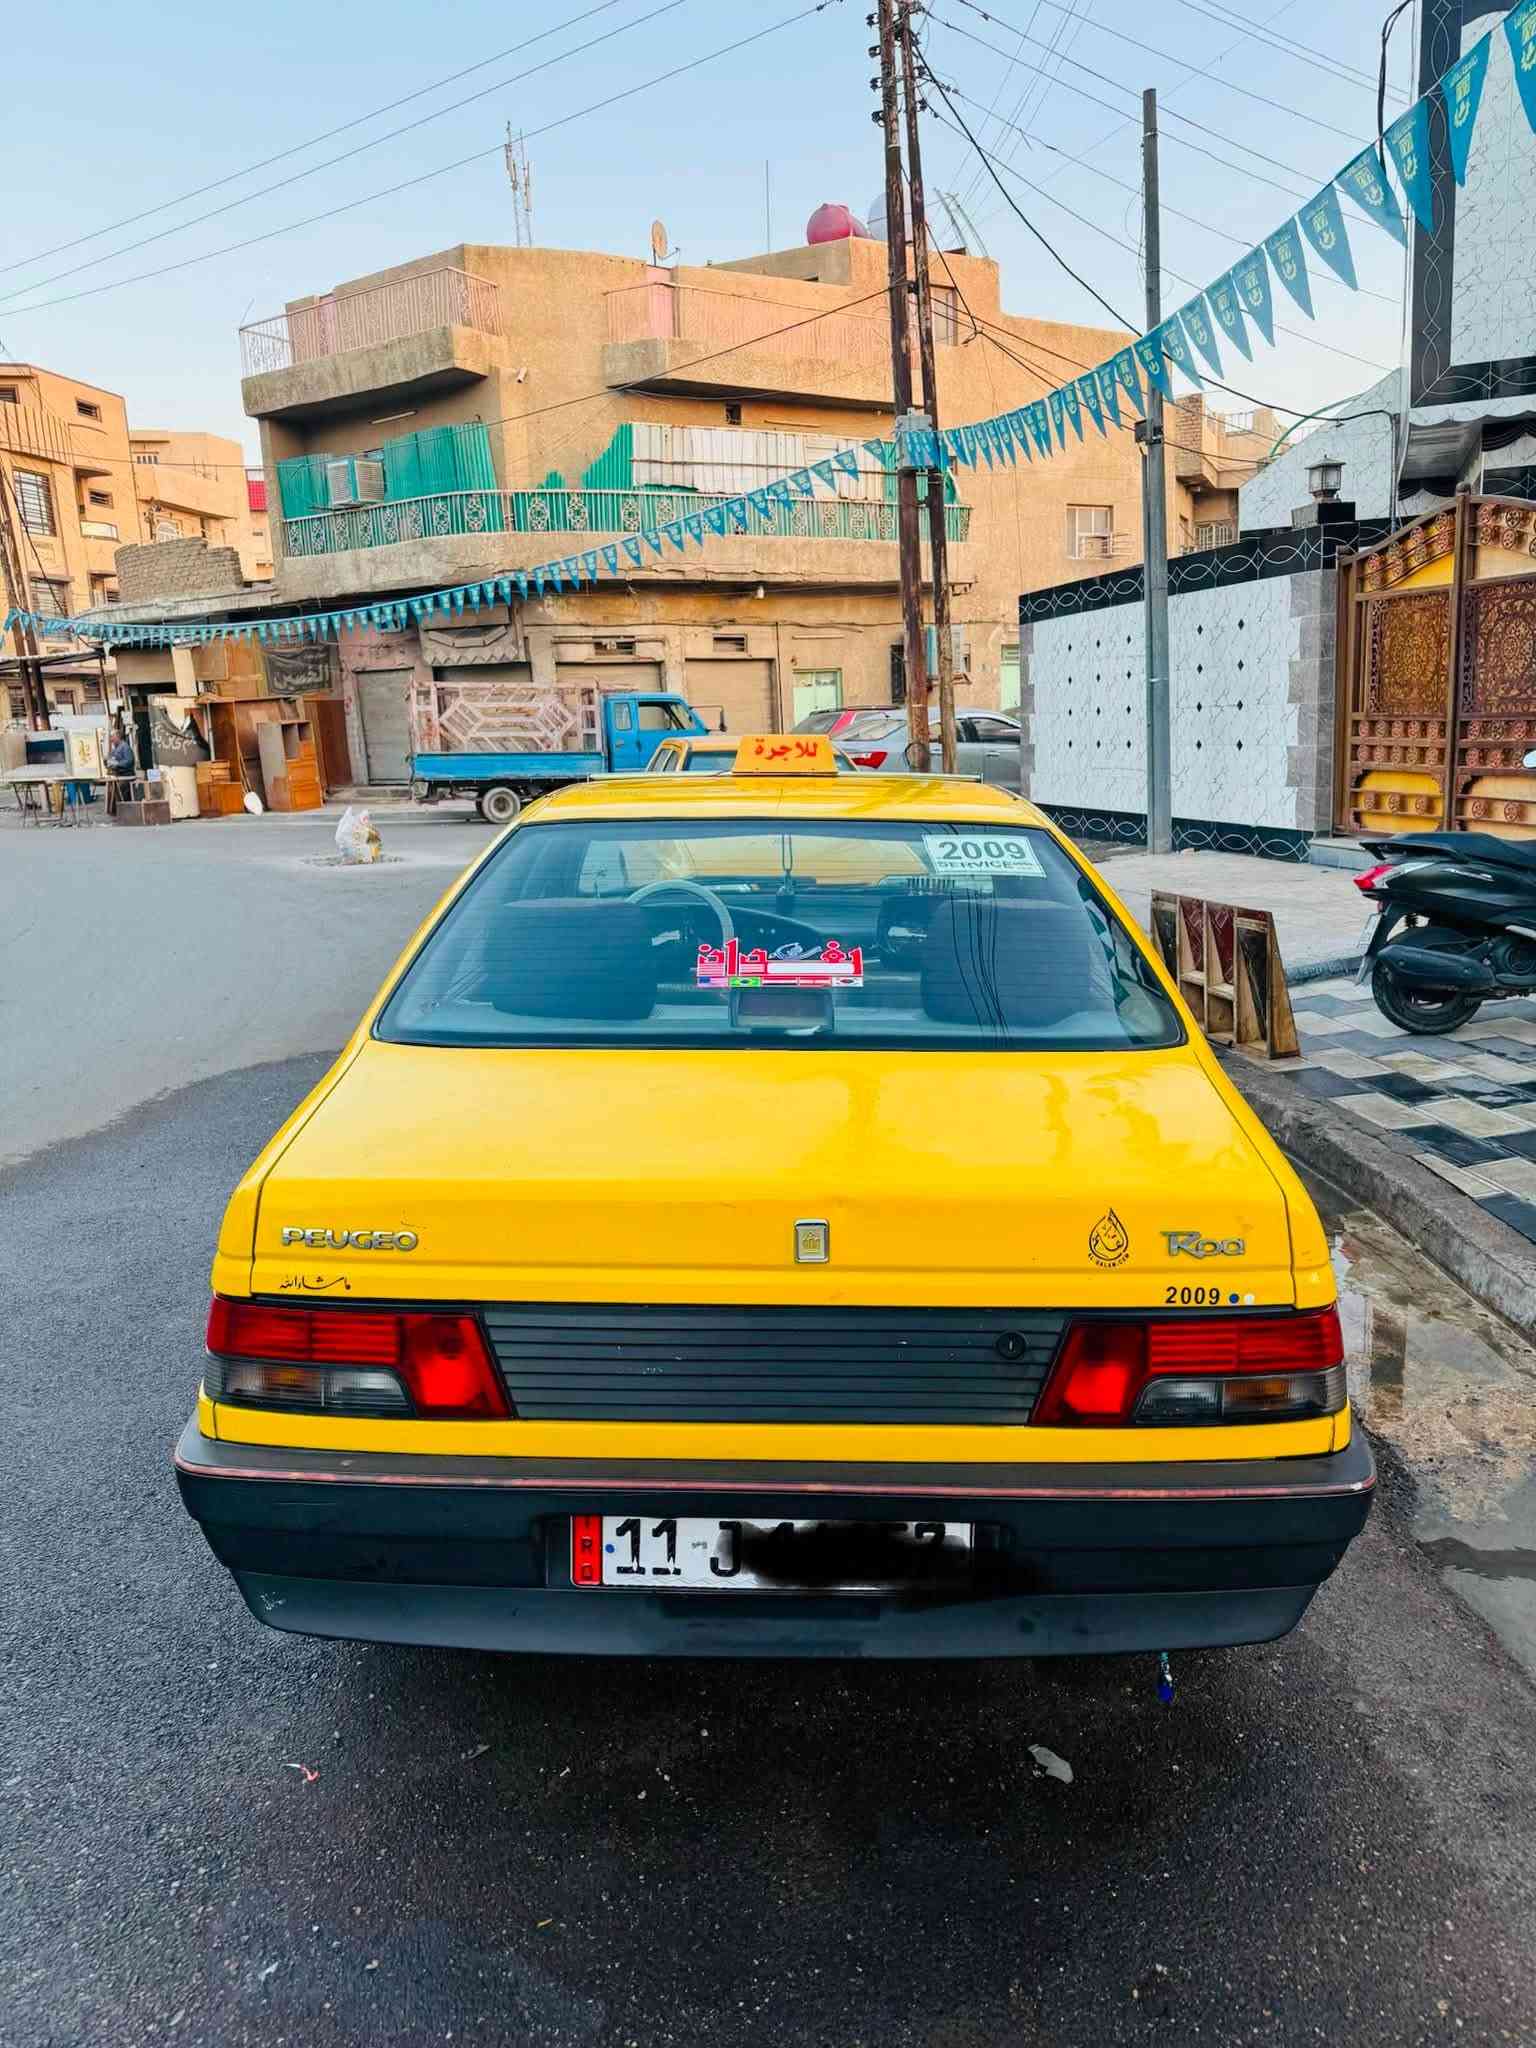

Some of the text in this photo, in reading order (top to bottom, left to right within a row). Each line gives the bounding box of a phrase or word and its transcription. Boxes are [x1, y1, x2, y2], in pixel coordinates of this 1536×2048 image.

[936, 841, 1026, 860] 2009
[282, 1227, 418, 1251] PEUGEO
[1165, 1286, 1220, 1305] 2009
[615, 1518, 682, 1576] 11
